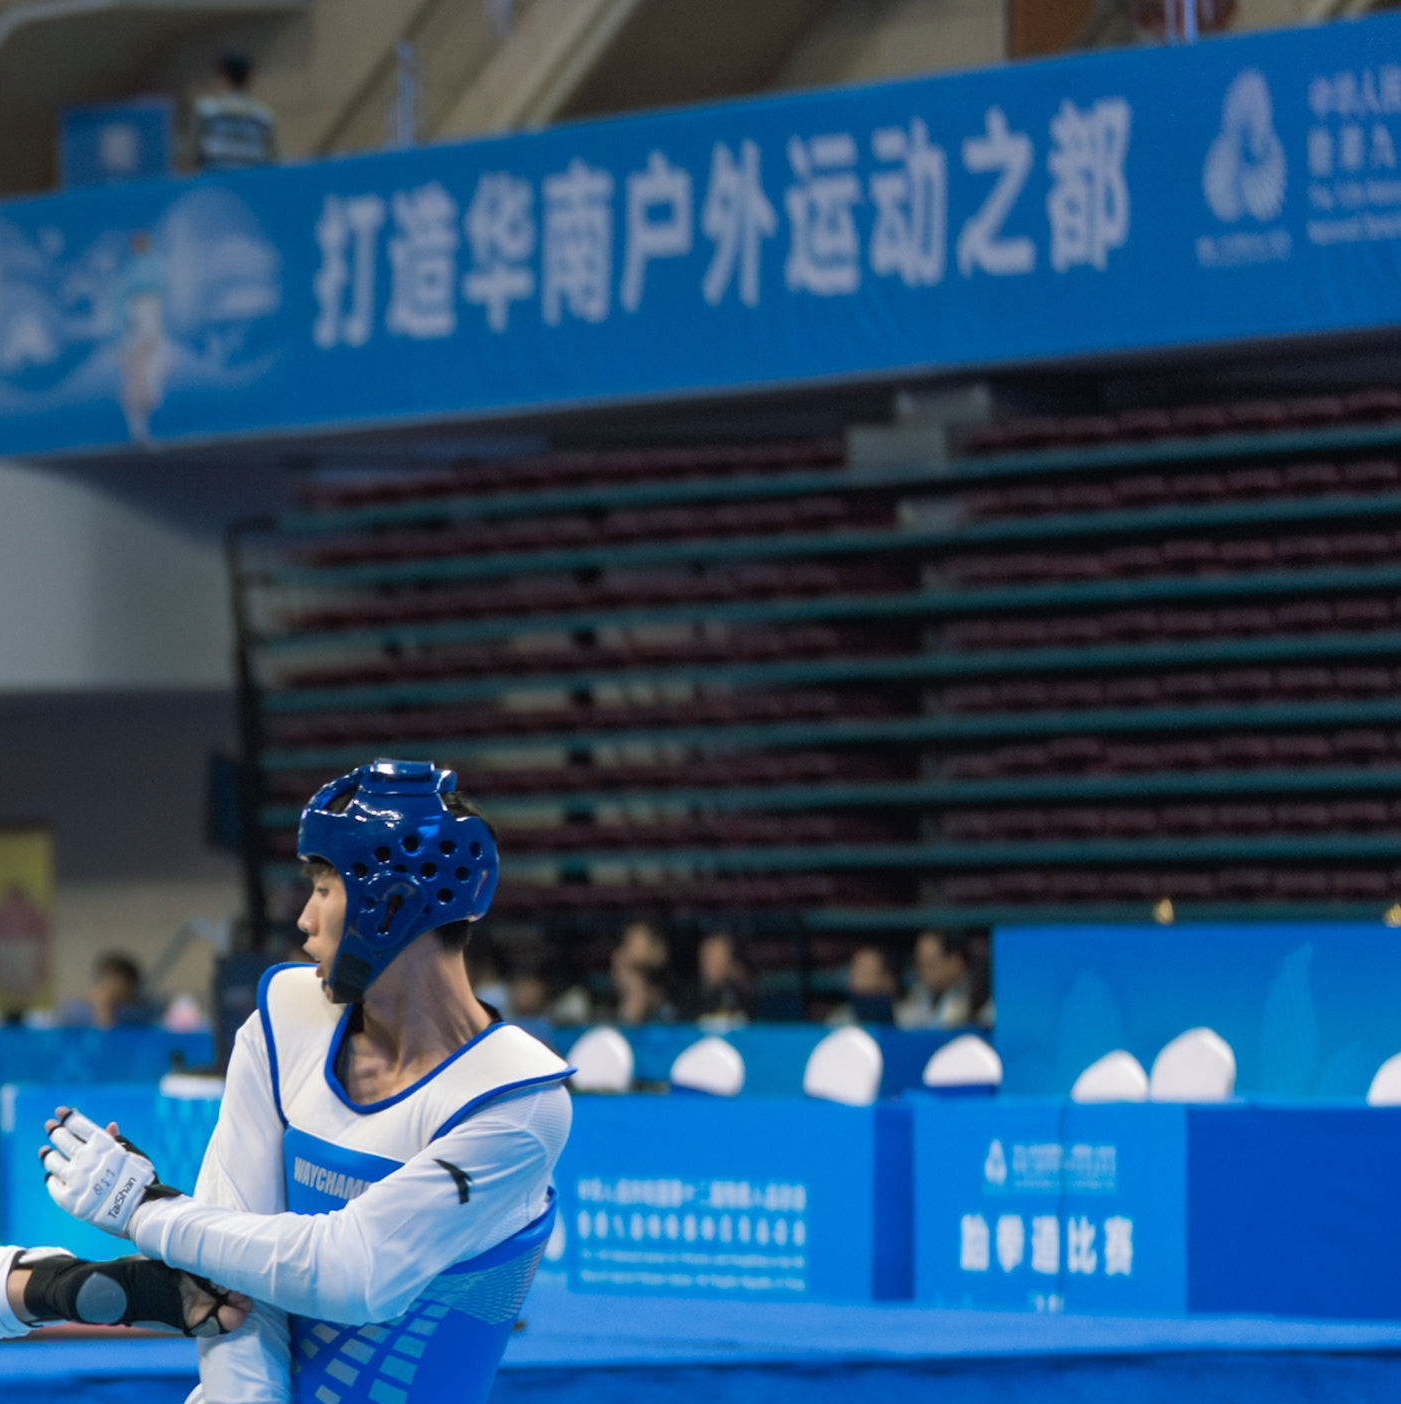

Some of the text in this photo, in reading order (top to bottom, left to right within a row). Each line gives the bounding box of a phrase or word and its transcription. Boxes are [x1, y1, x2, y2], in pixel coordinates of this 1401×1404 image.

[312, 97, 1132, 349] 打造华南户外运动之都
[107, 1176, 138, 1220] TaiShan
[960, 1213, 1134, 1276] 跆拳道比赛
